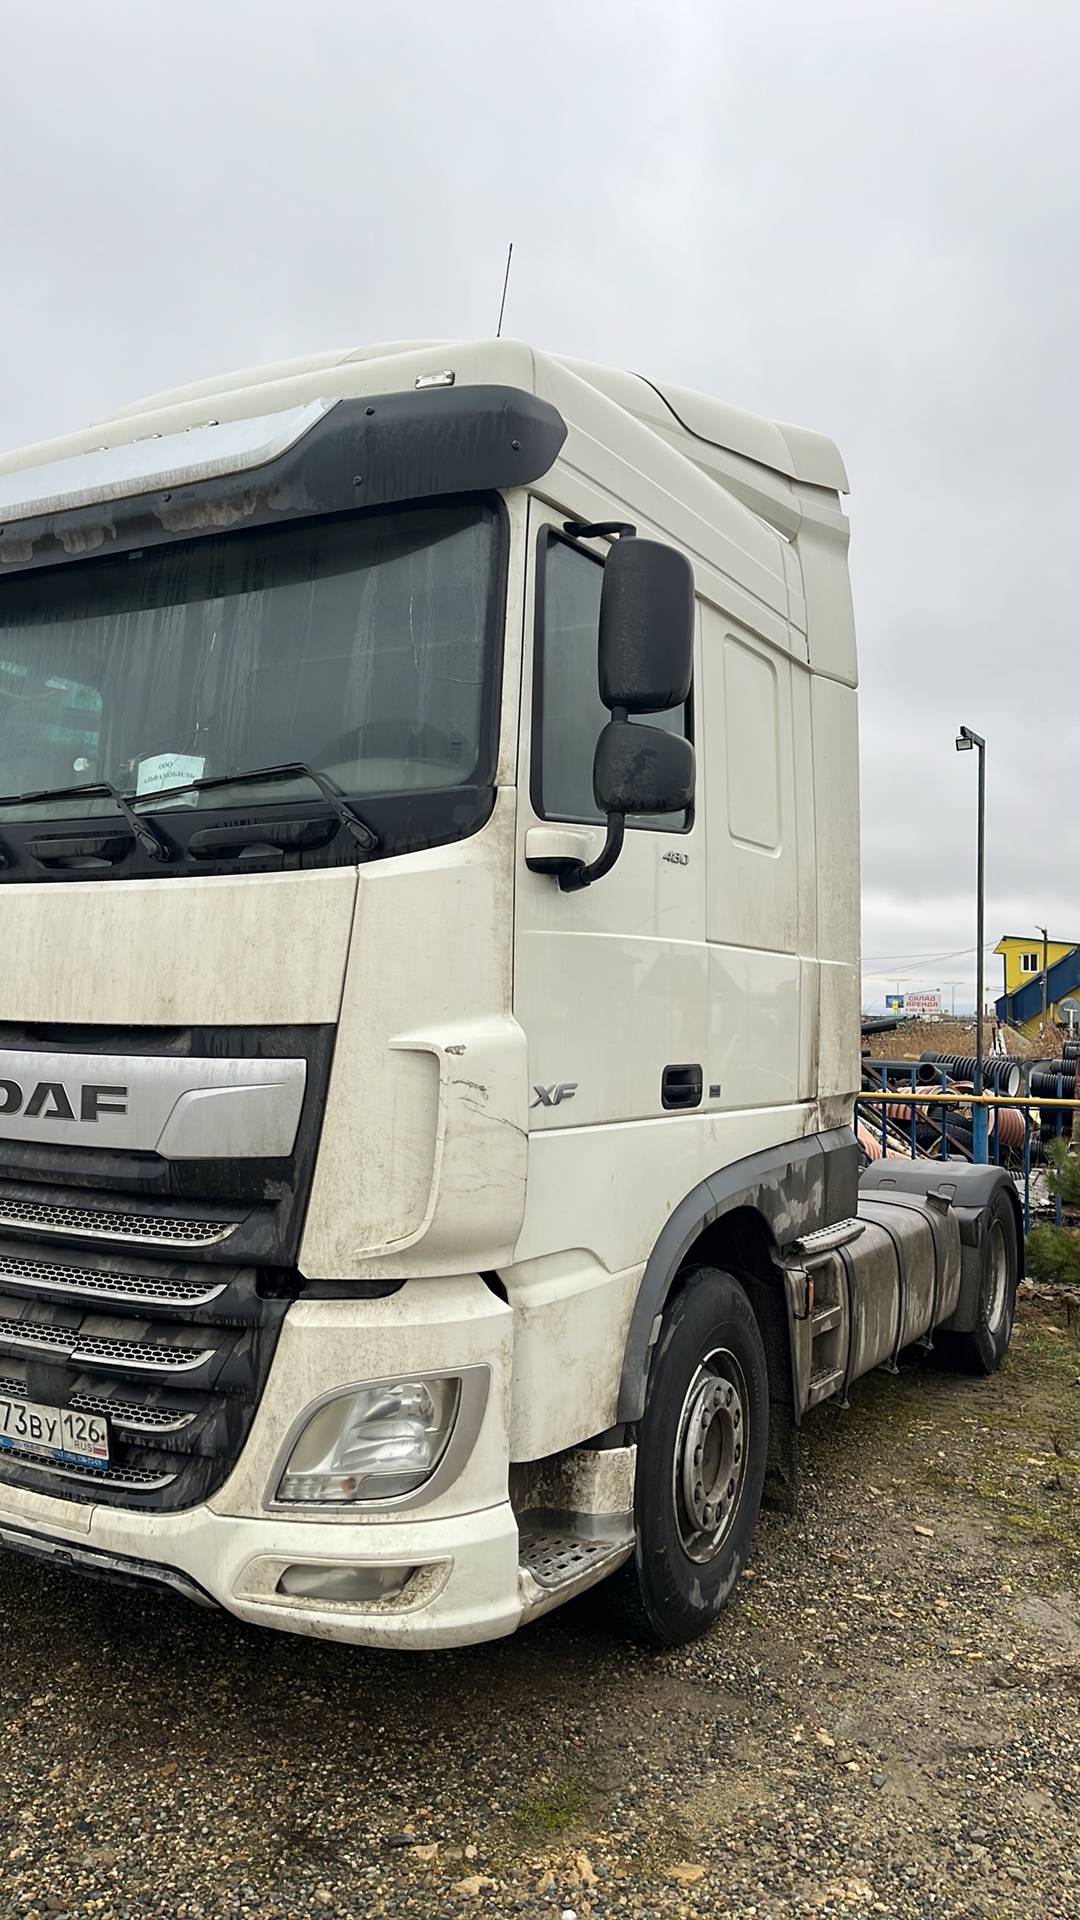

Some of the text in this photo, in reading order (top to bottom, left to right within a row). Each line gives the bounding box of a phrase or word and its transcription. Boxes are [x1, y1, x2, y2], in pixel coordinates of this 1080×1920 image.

[529, 1083, 578, 1108] XF
[63, 1414, 100, 1443] 126
[74, 1440, 94, 1451] RUS
